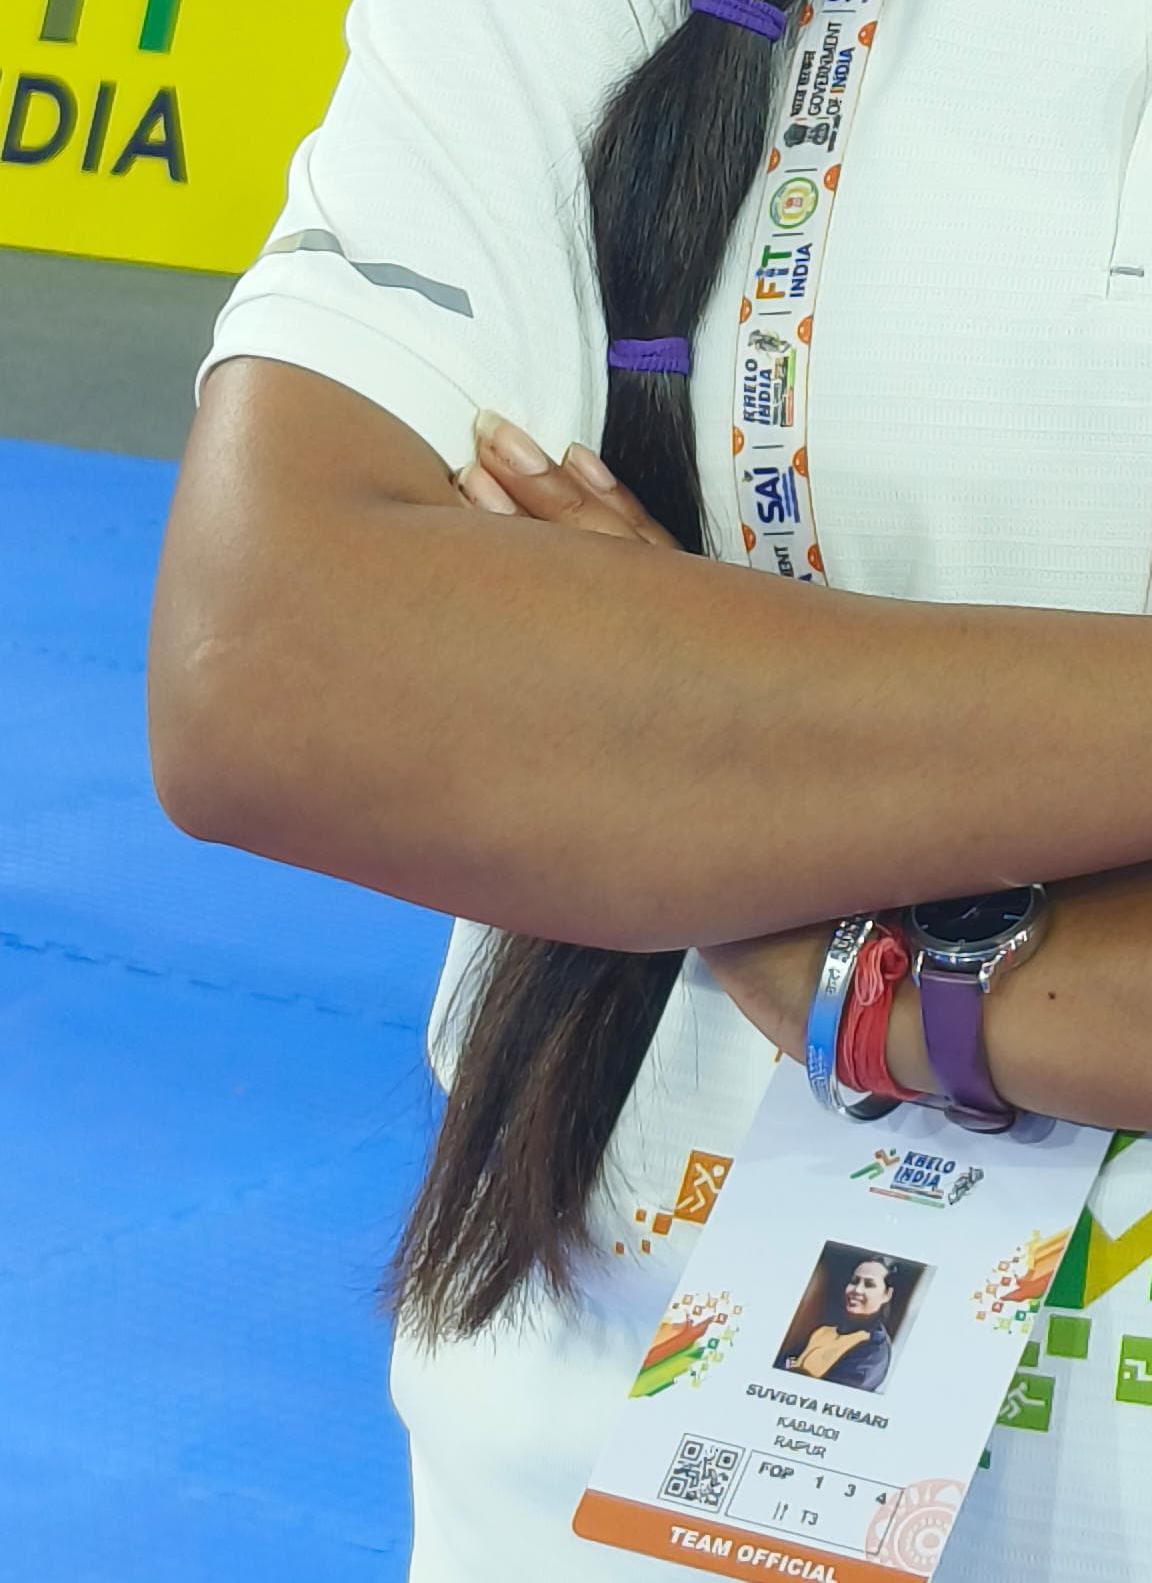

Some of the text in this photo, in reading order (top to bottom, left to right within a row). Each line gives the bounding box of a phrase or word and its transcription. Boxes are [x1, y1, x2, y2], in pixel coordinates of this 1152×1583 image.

[0, 72, 188, 185] DIA
[789, 242, 813, 298] INDIA
[743, 358, 759, 423] KHELO
[758, 368, 773, 425] INDIA
[752, 467, 785, 523] SAI
[893, 1166, 941, 1188] INDIA
[776, 1416, 841, 1441] KABADDI
[821, 1402, 889, 1430] KUMARI
[758, 1461, 887, 1505] FOP 1 3 4
[800, 1508, 819, 1526] T3
[671, 1526, 839, 1583] TEAM OFFICIAL
